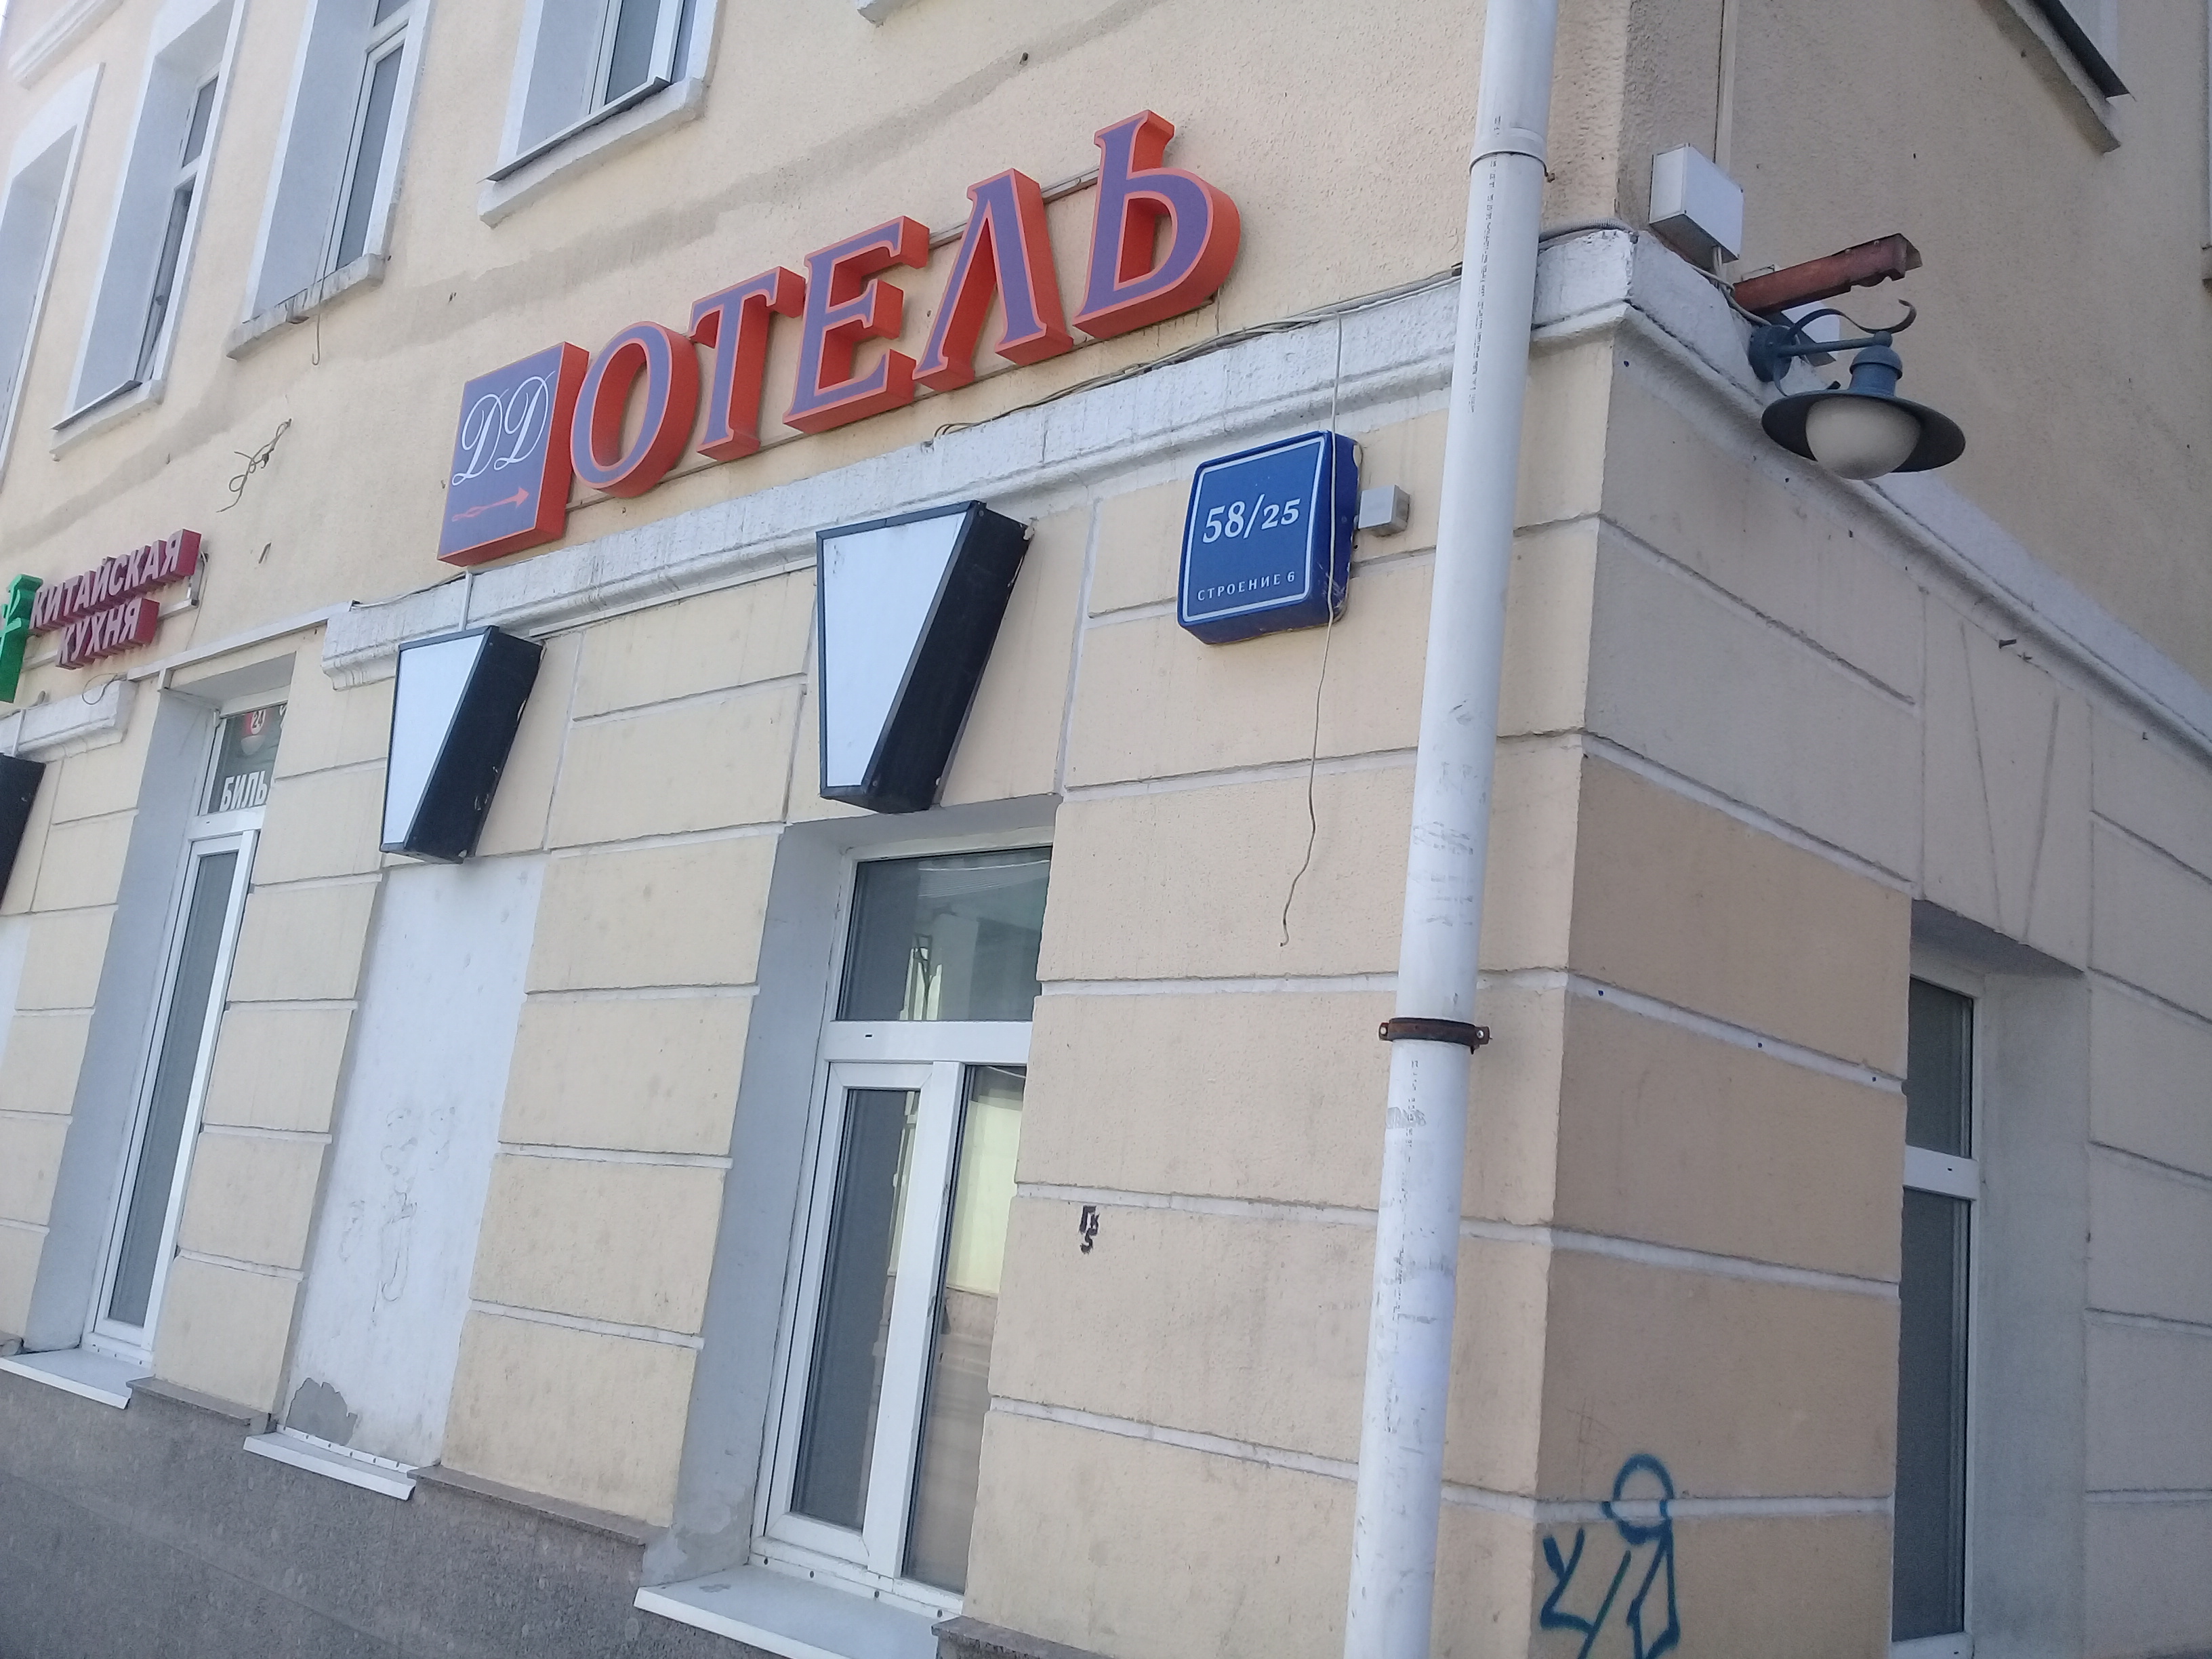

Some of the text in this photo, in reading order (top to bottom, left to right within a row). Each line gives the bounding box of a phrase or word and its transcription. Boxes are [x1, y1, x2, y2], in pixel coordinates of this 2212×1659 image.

[571, 109, 1228, 495] ОТЕЛЬ
[1202, 493, 1301, 544] 58/25
[29, 529, 186, 630] КИТАЙСКАЯ
[1197, 571, 1296, 600] СТРОЕНИЕ 6
[56, 597, 144, 667] КУХНЯ
